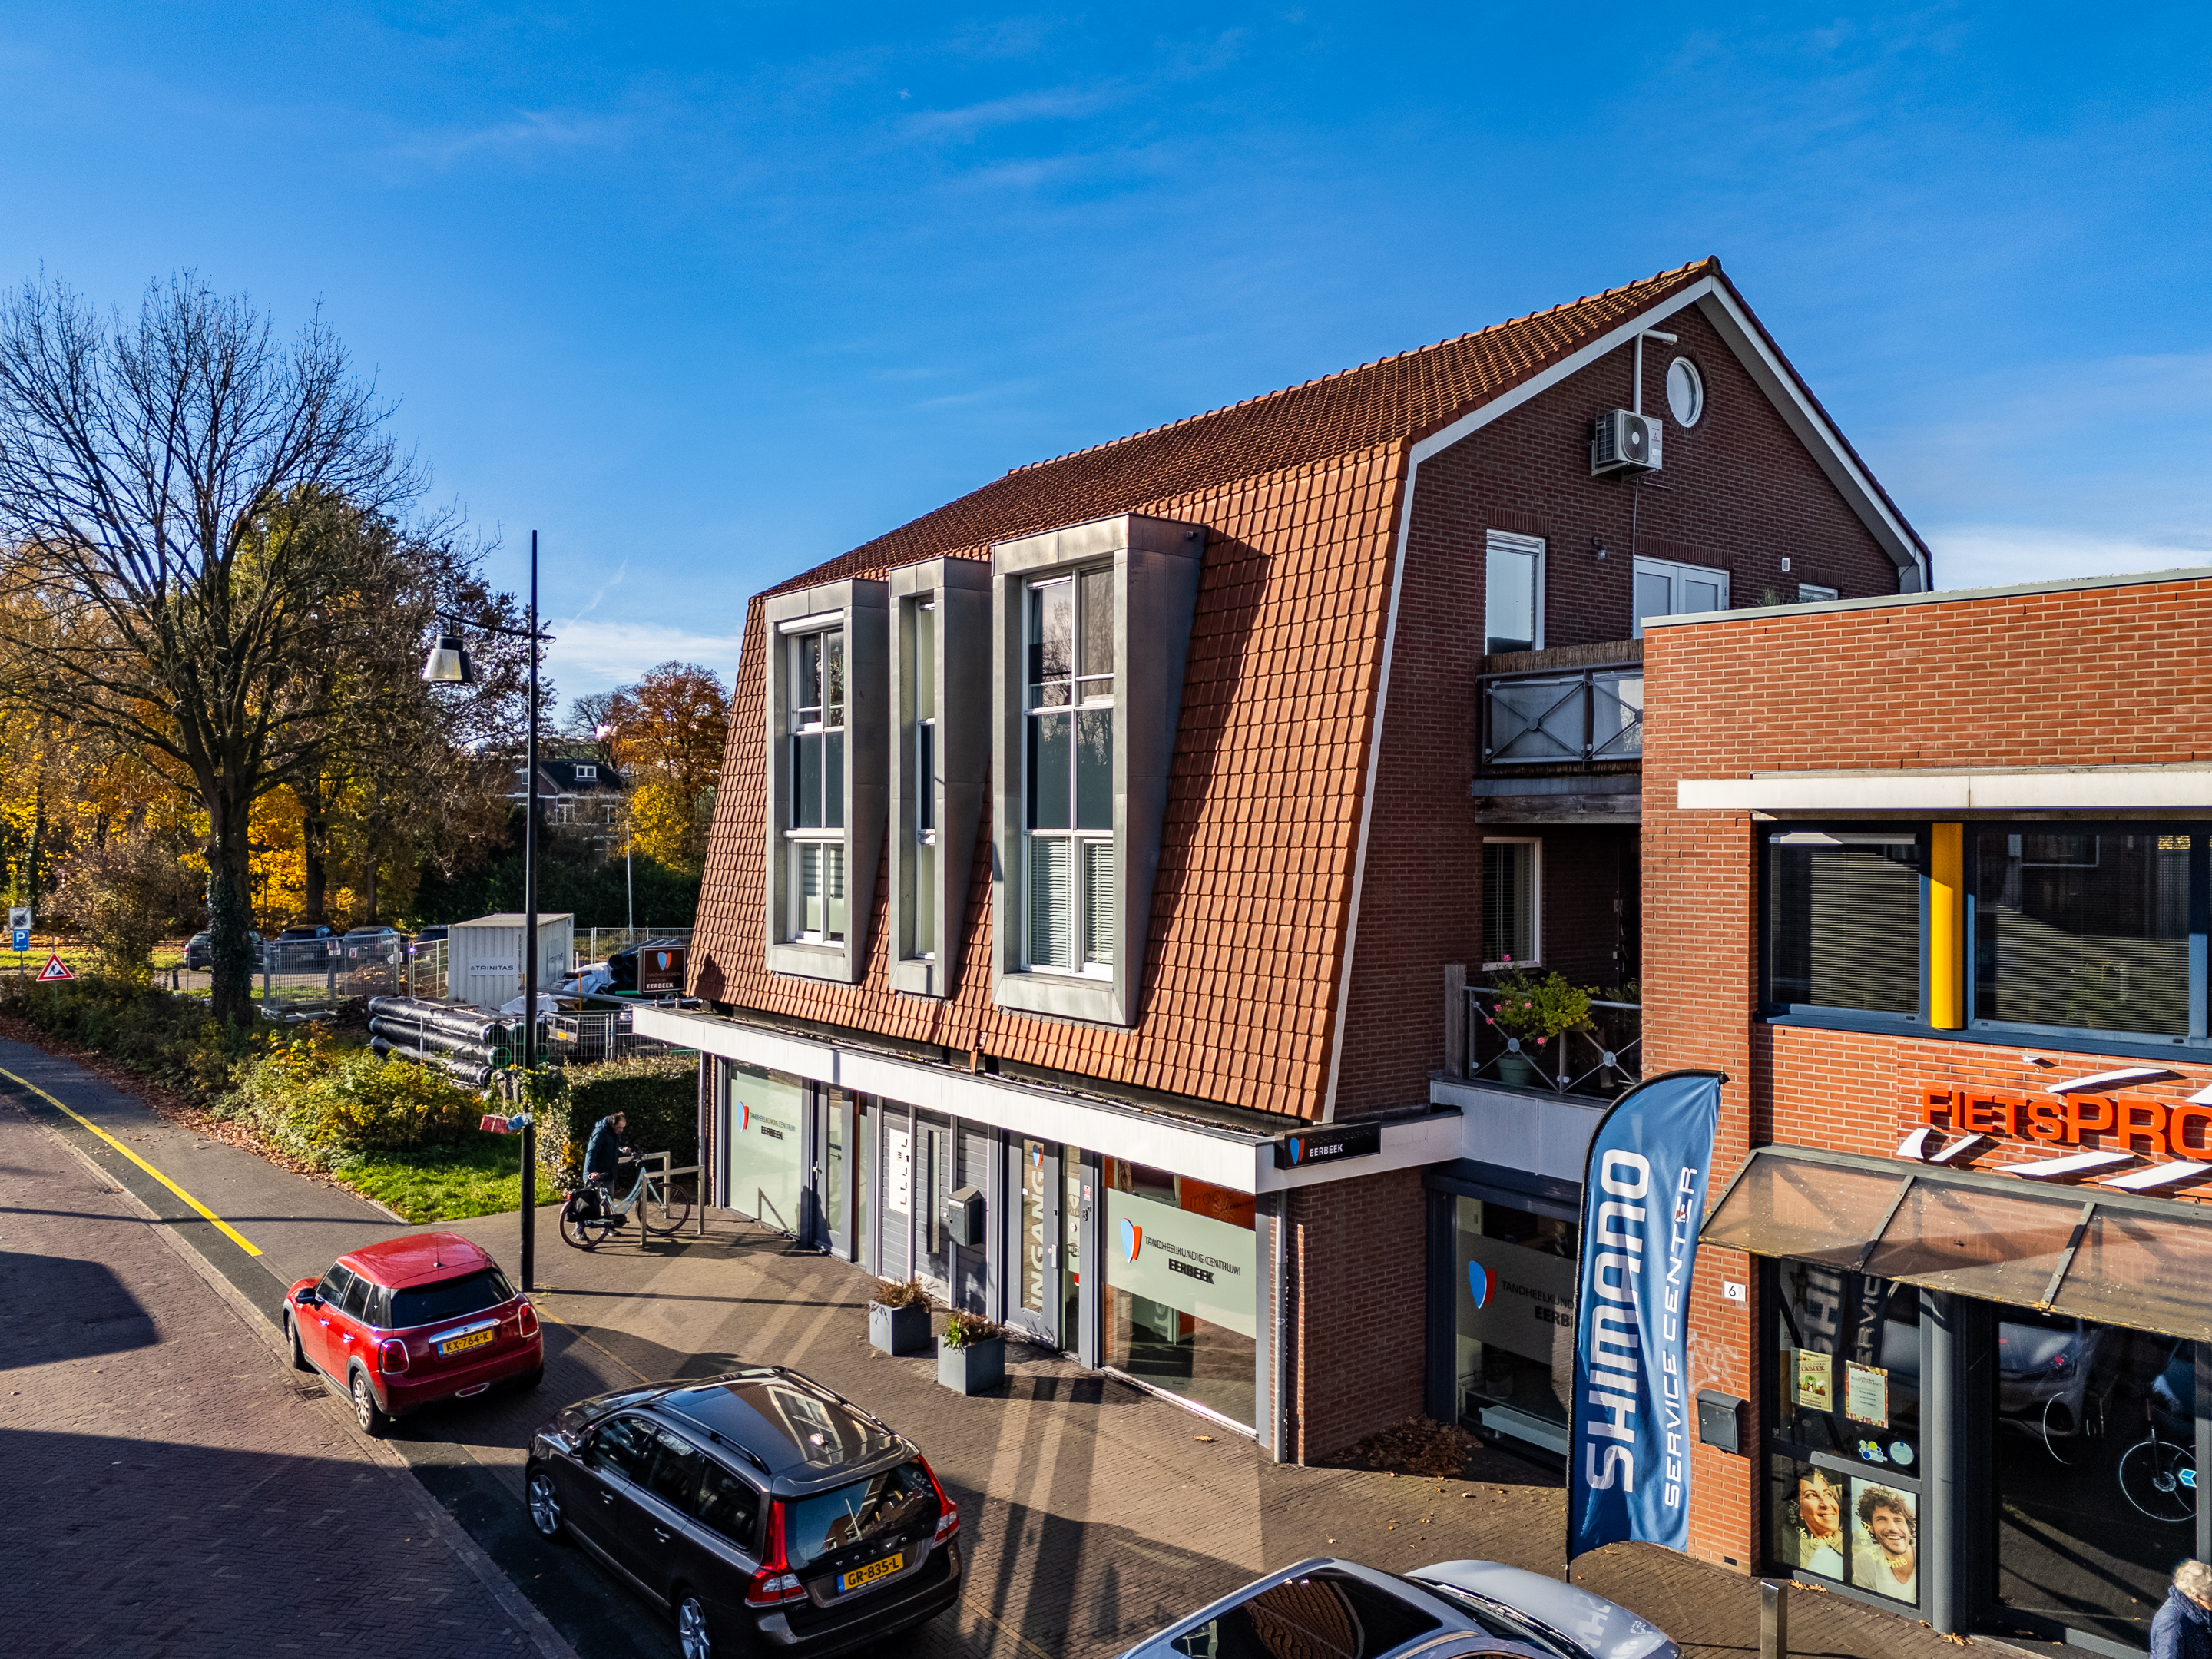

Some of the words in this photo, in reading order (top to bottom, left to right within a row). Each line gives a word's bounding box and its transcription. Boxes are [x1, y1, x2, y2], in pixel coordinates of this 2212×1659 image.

[16, 932, 25, 943] P
[761, 1125, 783, 1141] EERBEEK
[1310, 1144, 1343, 1157] EERBEEK
[1031, 1170, 1044, 1307] INGANG
[1144, 1236, 1204, 1264] TANDHEELKUNDIG
[1204, 1256, 1241, 1276] CENTRUM
[1663, 1167, 1698, 1341] CENTER
[1168, 1258, 1214, 1285] EERBEEK
[1728, 1285, 1737, 1296] 6
[1586, 1148, 1650, 1493] SHIMANO
[446, 1332, 490, 1352] KX-764-K
[1662, 1349, 1682, 1509] SERVICE
[1810, 1535, 1835, 1546] lente
[848, 1558, 899, 1586] GR-835-L
[1881, 1555, 1908, 1568] lente
